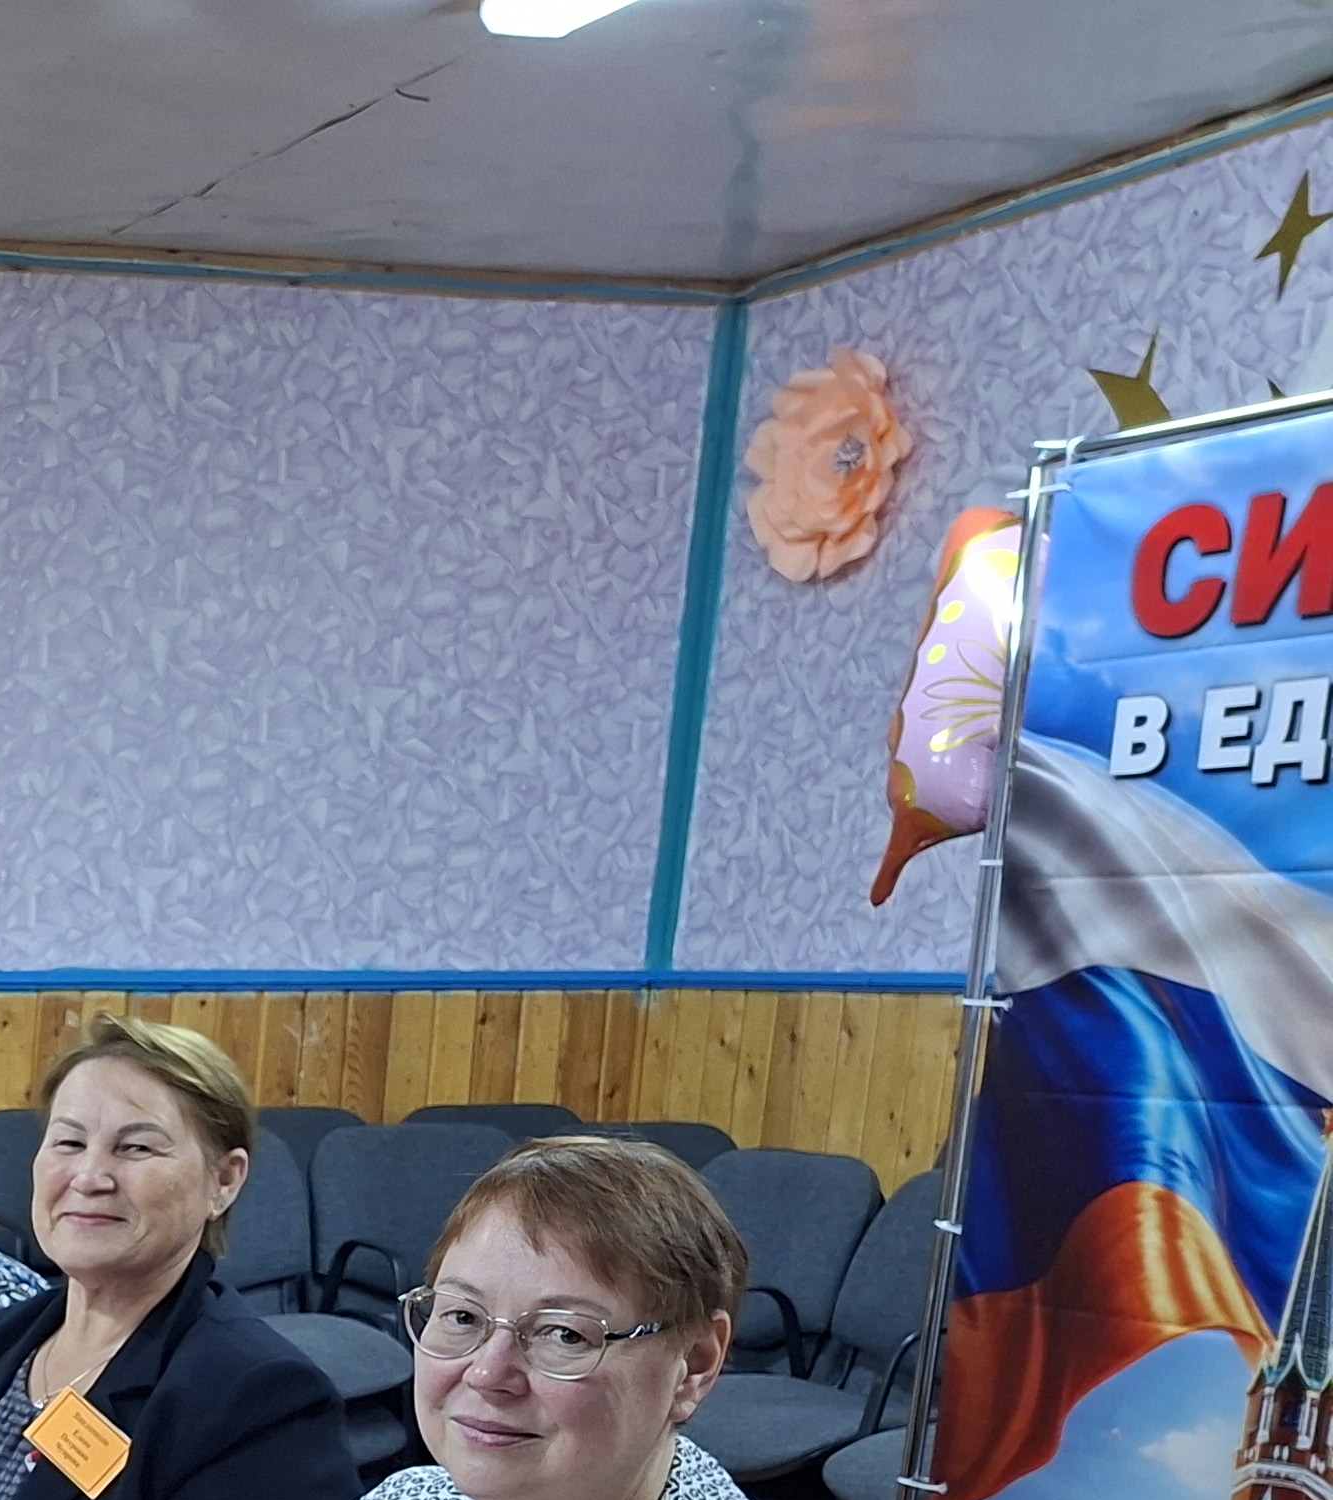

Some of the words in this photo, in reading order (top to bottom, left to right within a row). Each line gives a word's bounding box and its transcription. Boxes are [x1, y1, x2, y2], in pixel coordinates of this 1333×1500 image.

[1131, 482, 1333, 637] СИ
[1109, 696, 1169, 778] В
[1196, 677, 1333, 786] ЕД
